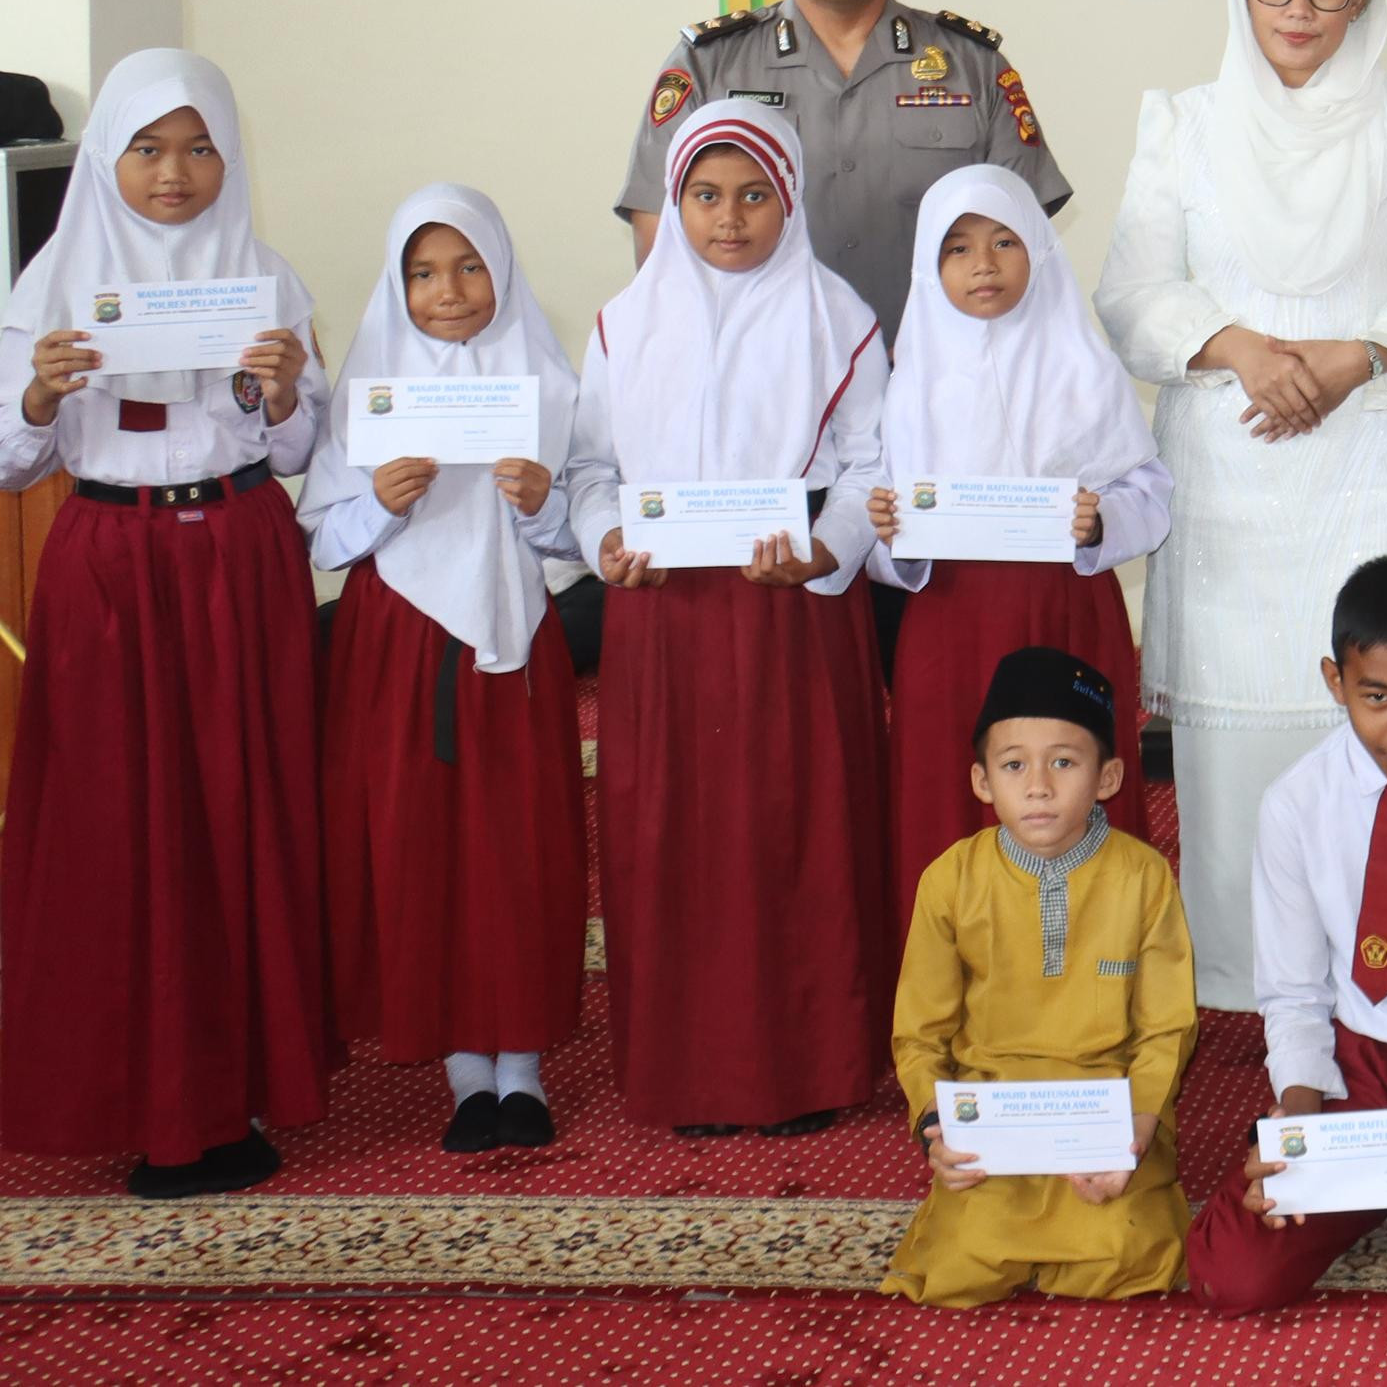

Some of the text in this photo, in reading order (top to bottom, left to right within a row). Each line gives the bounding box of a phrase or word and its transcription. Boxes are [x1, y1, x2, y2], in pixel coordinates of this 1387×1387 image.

[137, 285, 257, 300] MASJID BAITUSSALAMAH
[147, 297, 247, 310] POLRES PELALAWAN
[992, 1091, 1027, 1100] MASJID
[1002, 1102, 1042, 1112] POLRES
[1320, 1121, 1355, 1132] MASJID
[1331, 1133, 1370, 1144] POLRES
